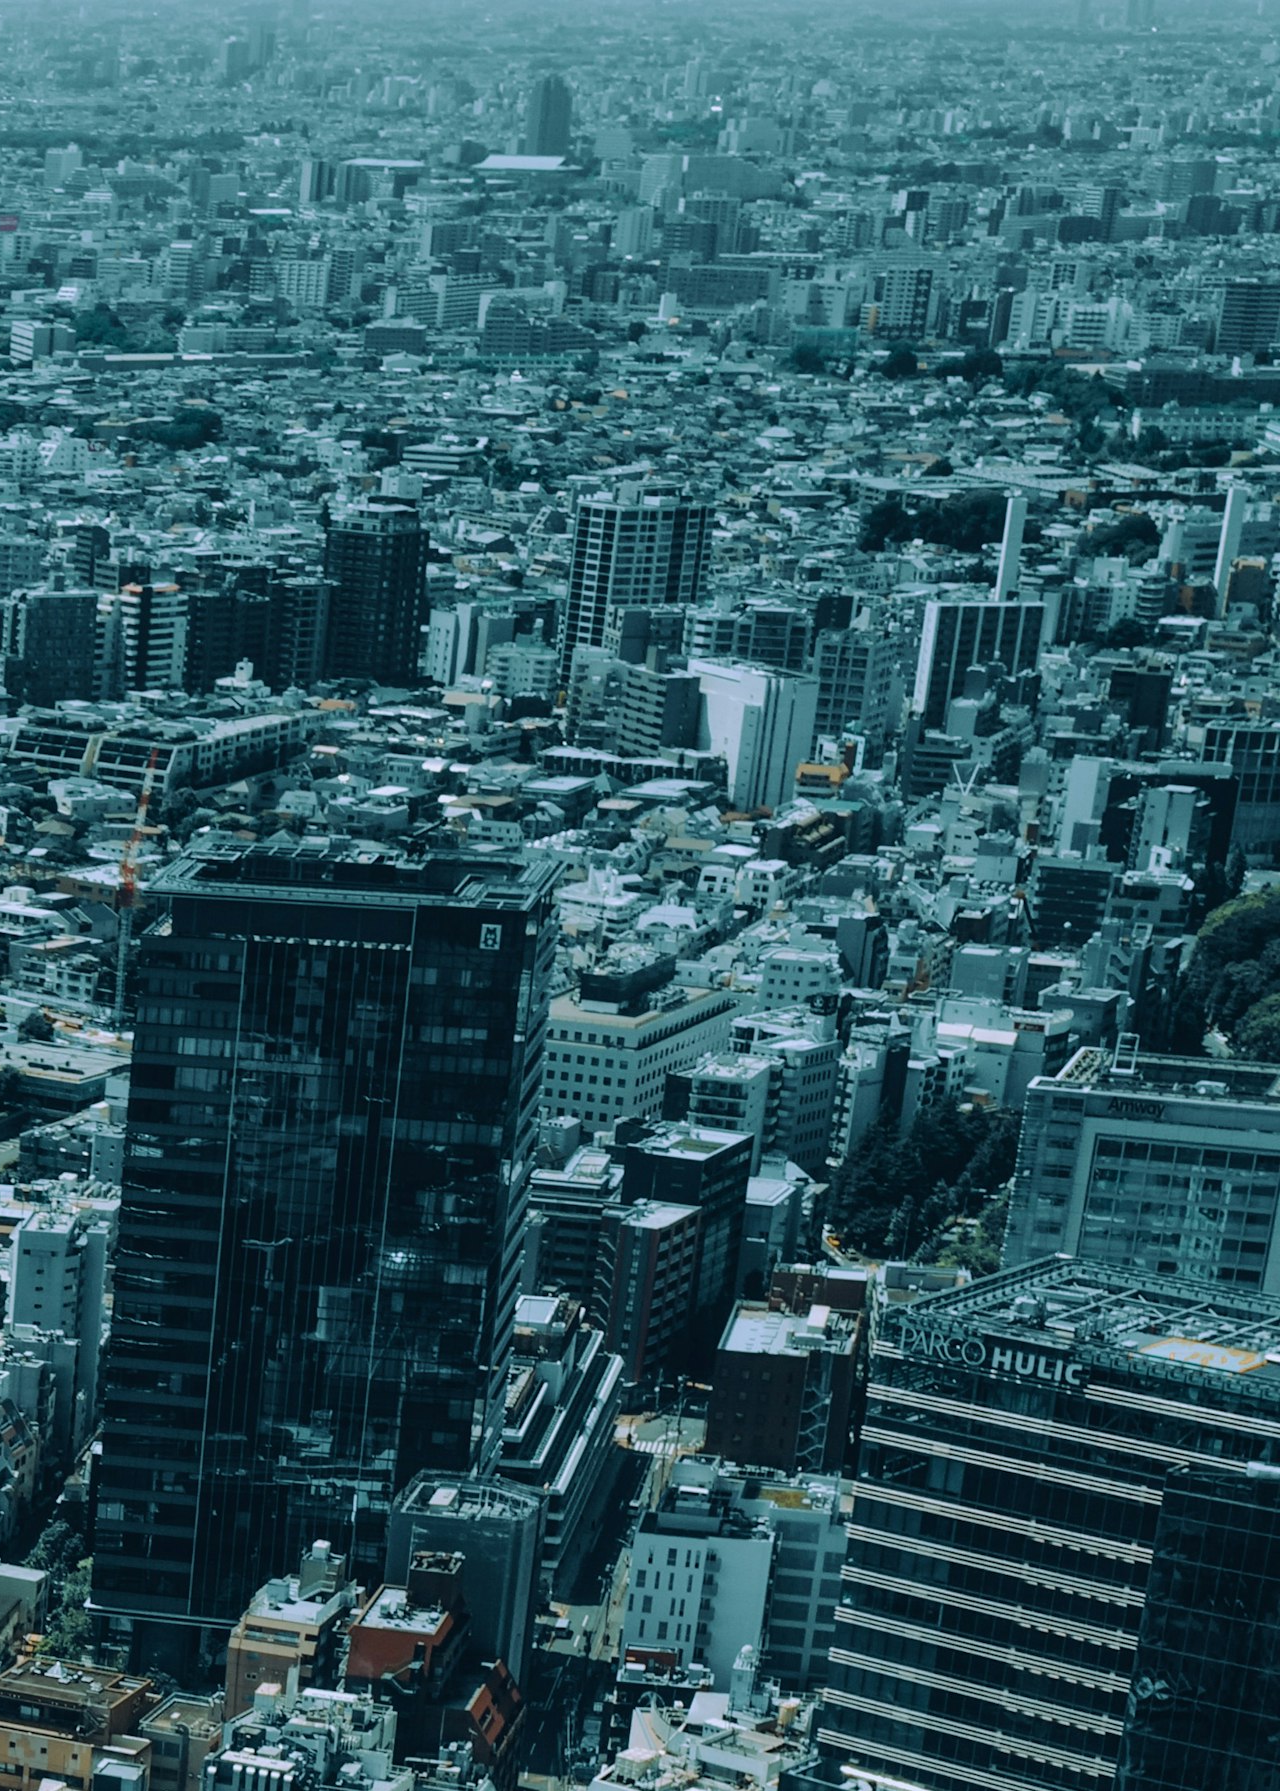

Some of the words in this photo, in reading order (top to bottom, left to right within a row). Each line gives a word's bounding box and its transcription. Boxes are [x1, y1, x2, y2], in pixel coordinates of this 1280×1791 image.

[1108, 1097, 1166, 1117] Amway
[901, 1324, 987, 1367] PARCO
[993, 1346, 1085, 1386] HULIC
